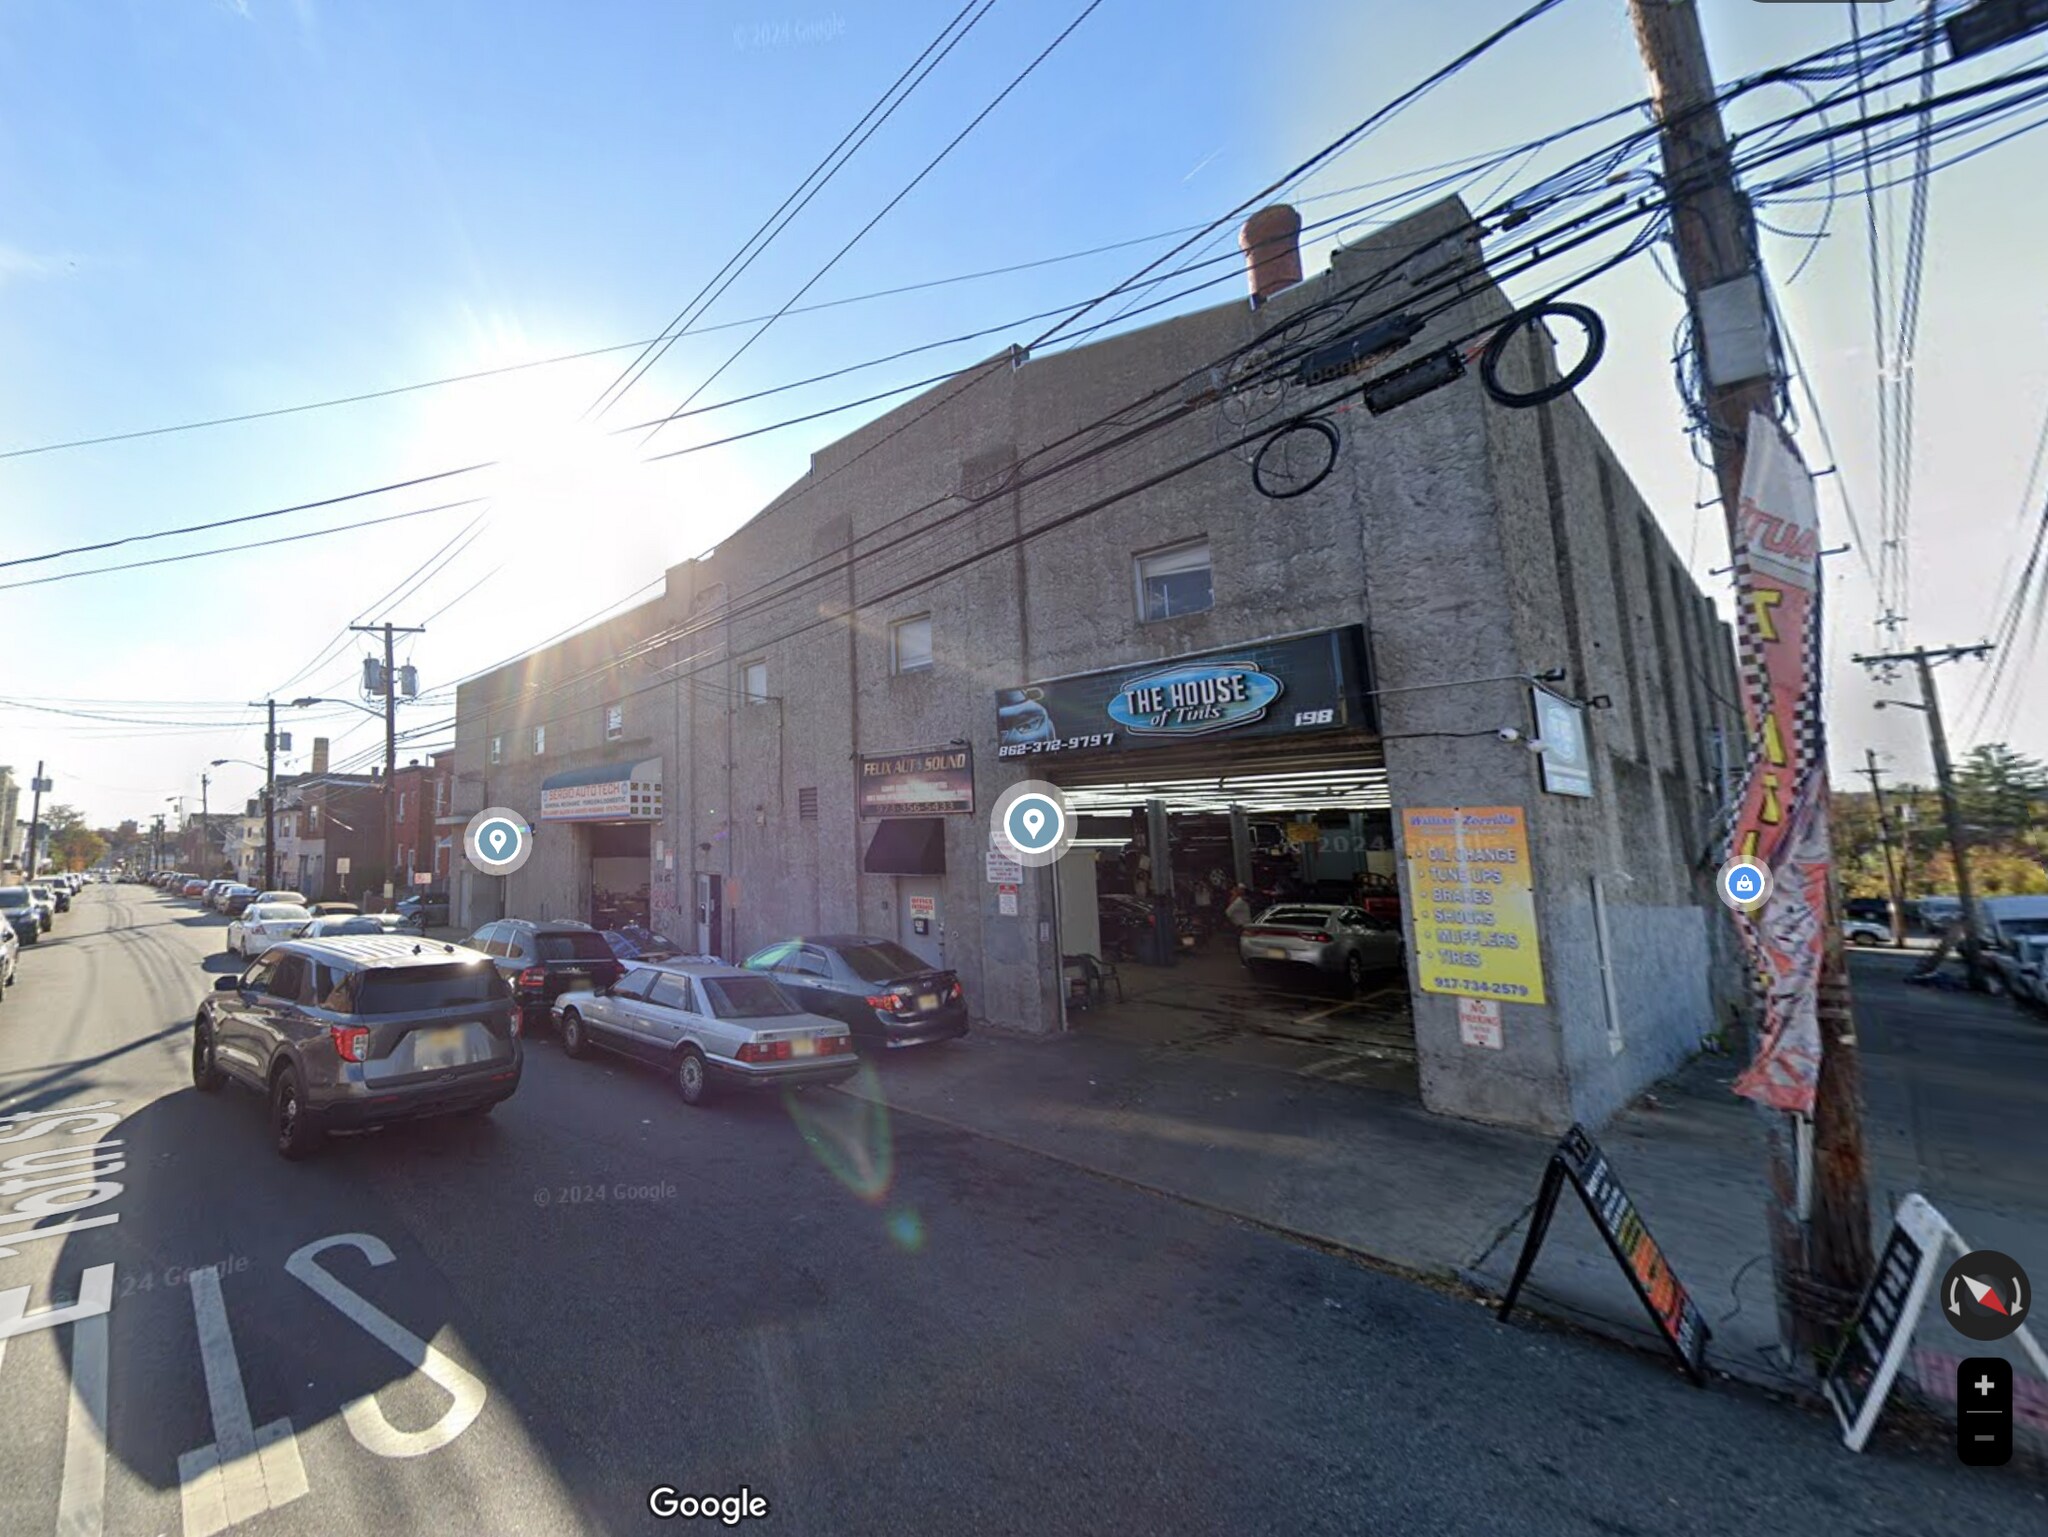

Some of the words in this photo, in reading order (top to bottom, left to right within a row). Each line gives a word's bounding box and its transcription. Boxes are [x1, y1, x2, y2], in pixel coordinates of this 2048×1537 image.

[1125, 686, 1164, 715] THE
[1171, 674, 1246, 708] HOUSE
[1150, 709, 1171, 727] of
[1176, 704, 1222, 724] Tints
[1294, 708, 1334, 727] 198
[998, 733, 1114, 757] 862-372-9797
[863, 762, 893, 777] FELIX
[924, 753, 966, 772] SOUND
[575, 784, 597, 798] AUTO
[597, 781, 620, 796] TECH
[1428, 848, 1453, 863] OIL
[1454, 848, 1517, 864] CHANGE
[1429, 867, 1469, 883] TUNE
[1472, 867, 1502, 884] UPS
[1432, 888, 1493, 905] BRAKES
[1436, 928, 1519, 950] MUFFLERS
[1438, 949, 1482, 968] TIRES
[1470, 1003, 1488, 1015] NO
